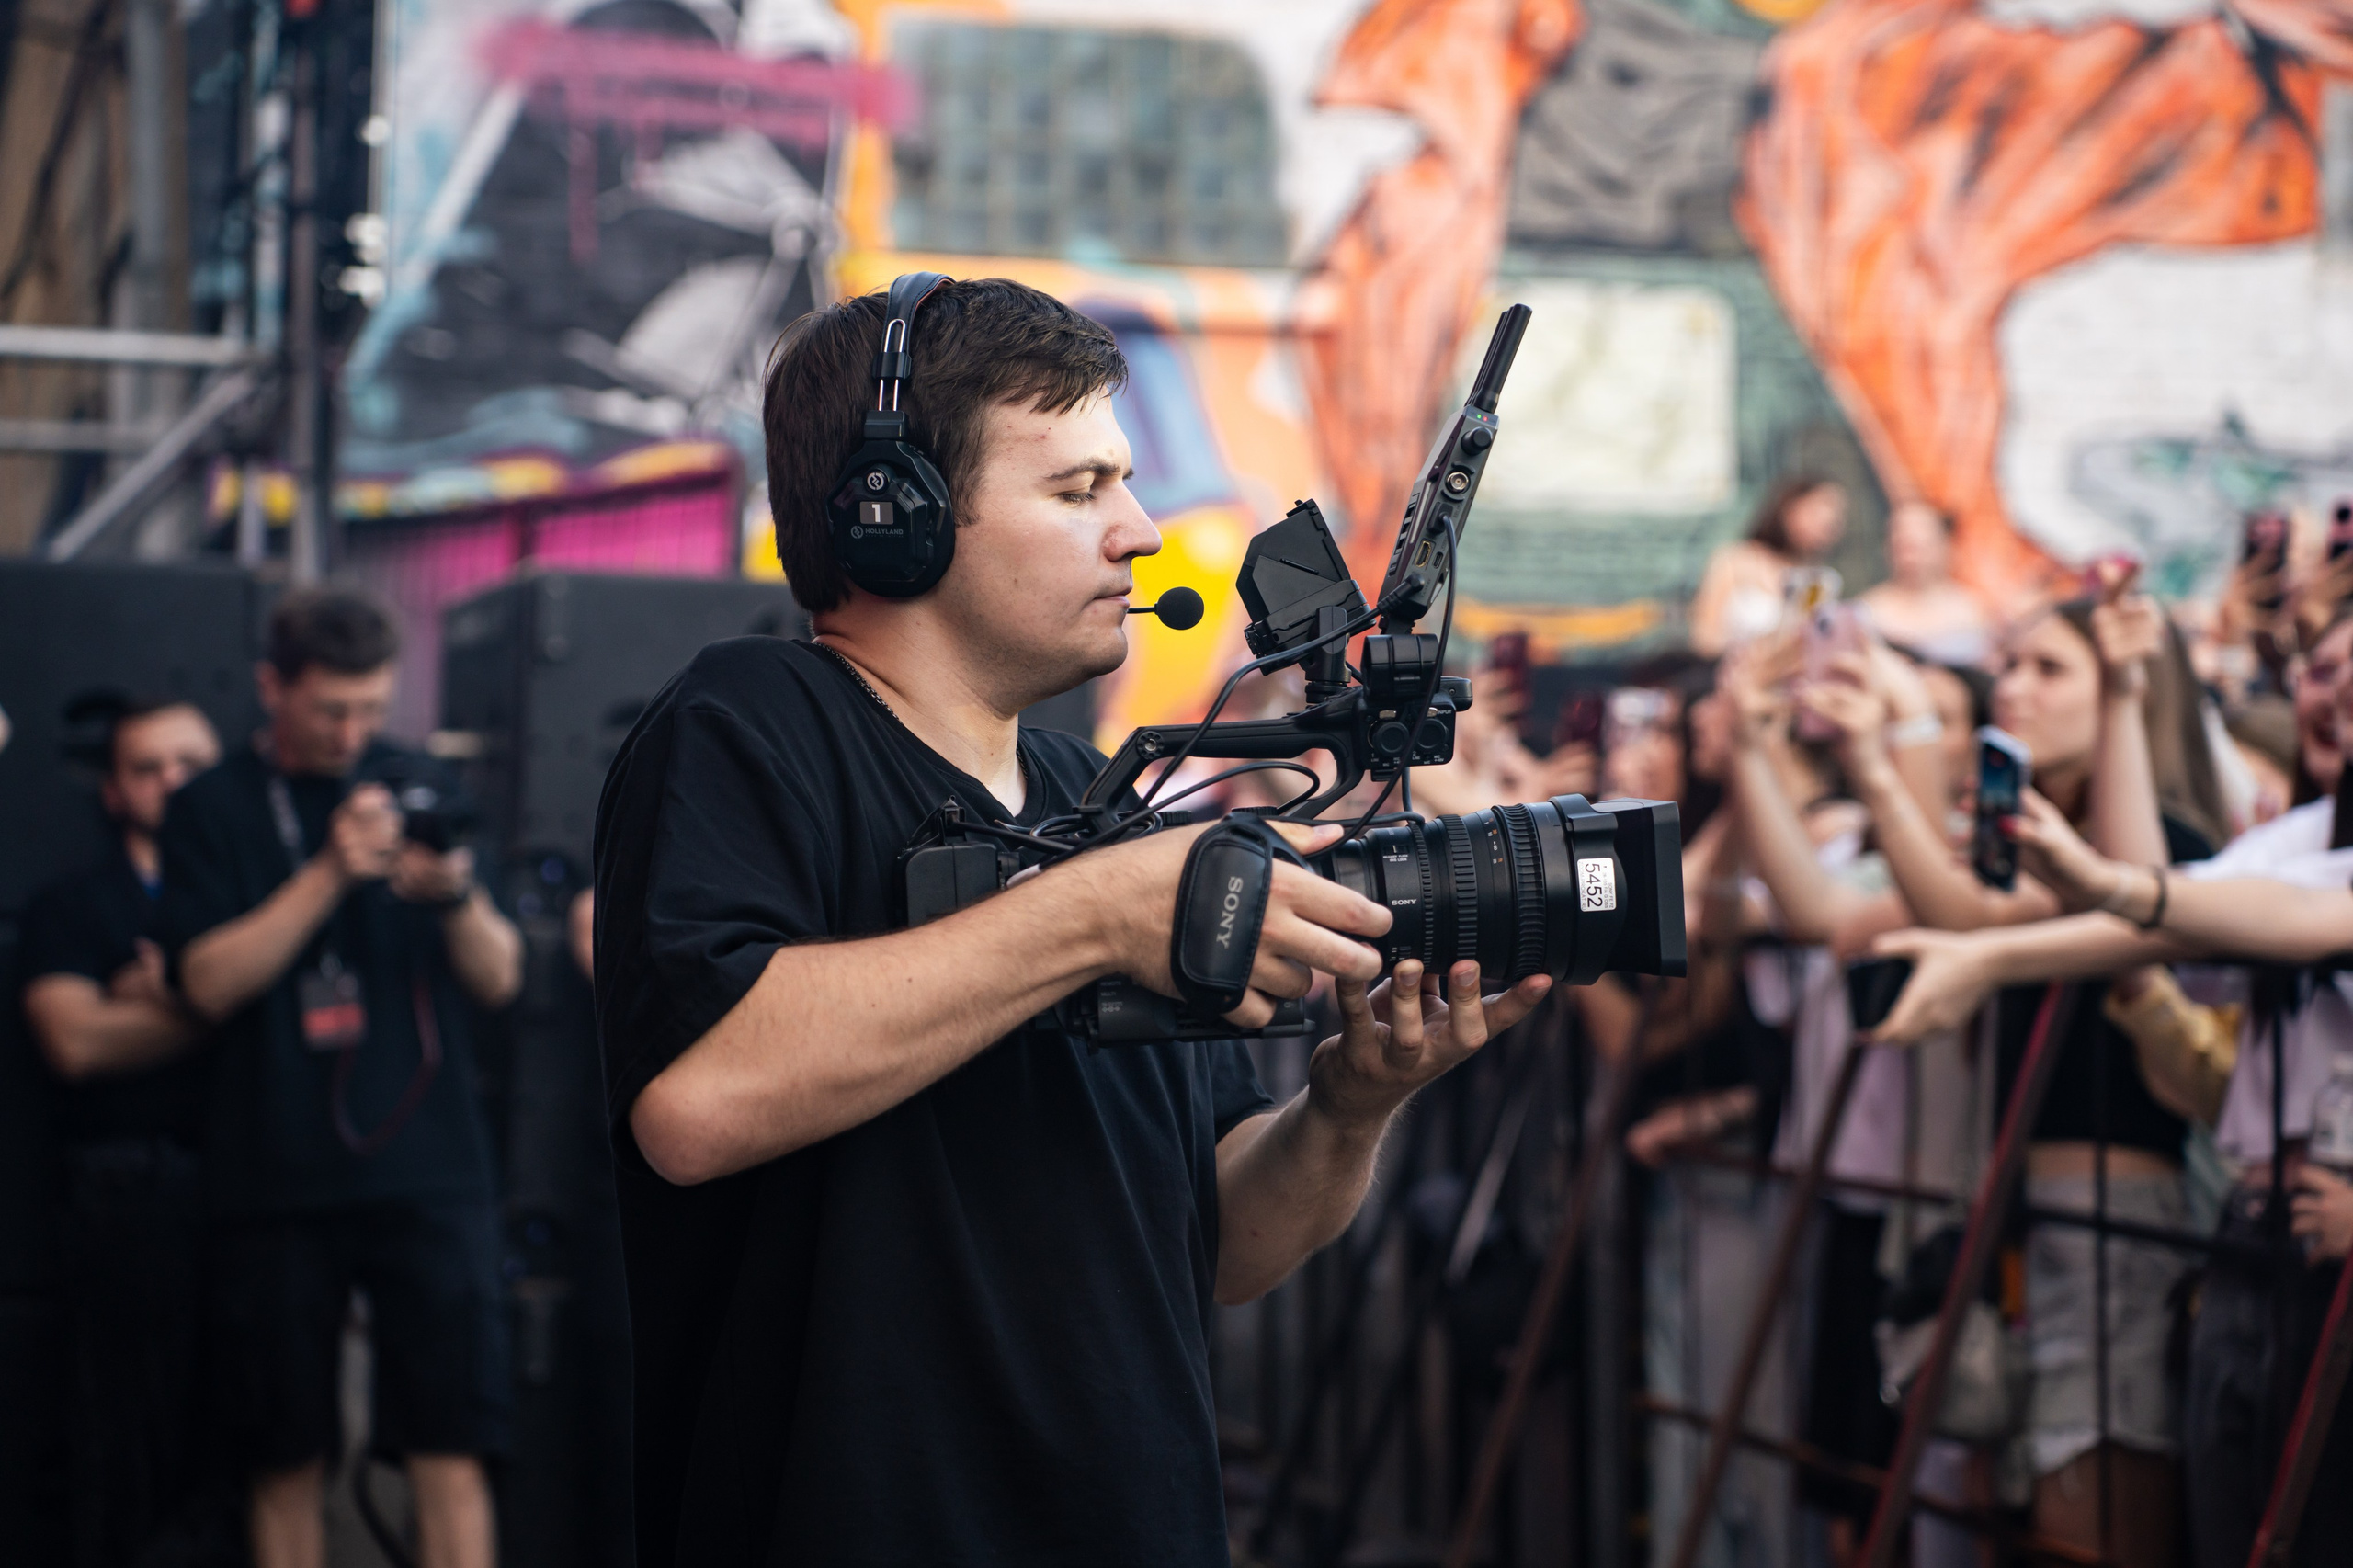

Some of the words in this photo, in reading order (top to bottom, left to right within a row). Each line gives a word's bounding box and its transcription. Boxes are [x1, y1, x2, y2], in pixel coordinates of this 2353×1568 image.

[872, 504, 881, 523] 1
[1585, 863, 1603, 908] 5452
[1216, 876, 1244, 949] SONY
